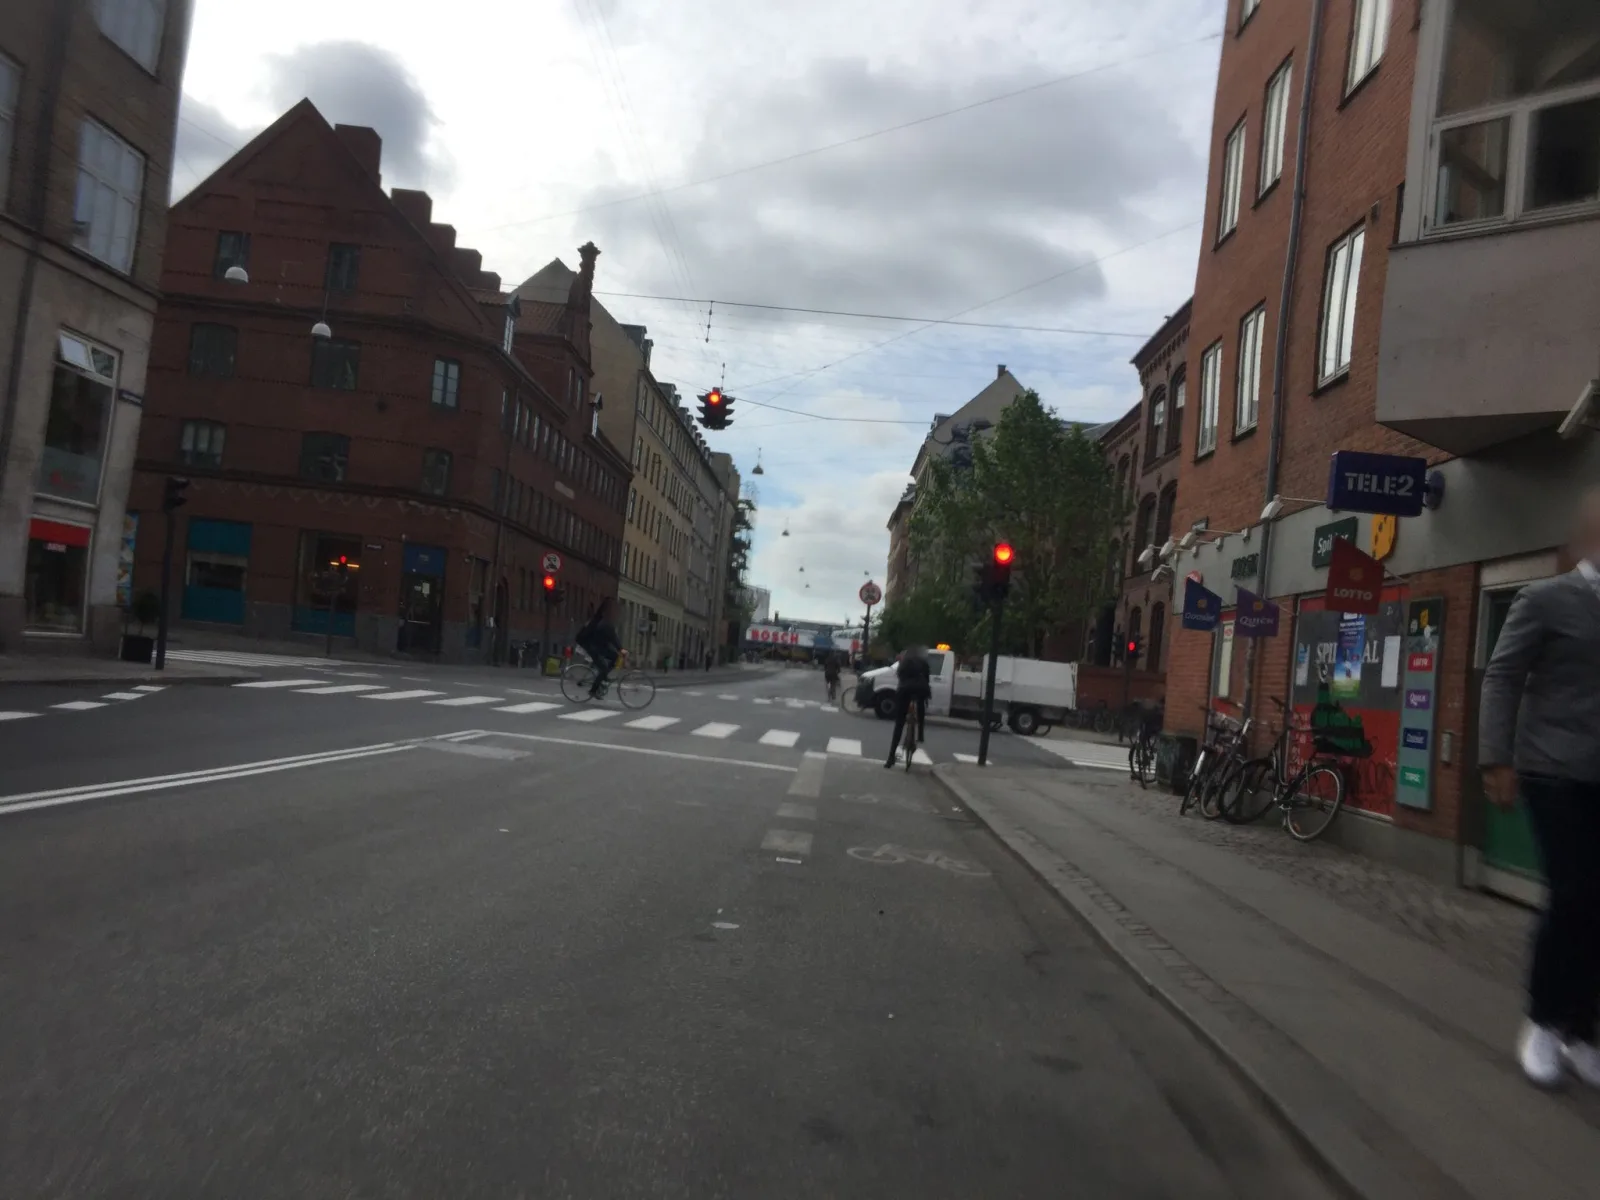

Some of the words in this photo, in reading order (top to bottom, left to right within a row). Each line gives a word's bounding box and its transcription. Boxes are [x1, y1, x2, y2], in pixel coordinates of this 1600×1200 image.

[1345, 472, 1414, 497] TELE2
[1333, 587, 1373, 601] LOTTO
[751, 628, 799, 644] BOSCH
